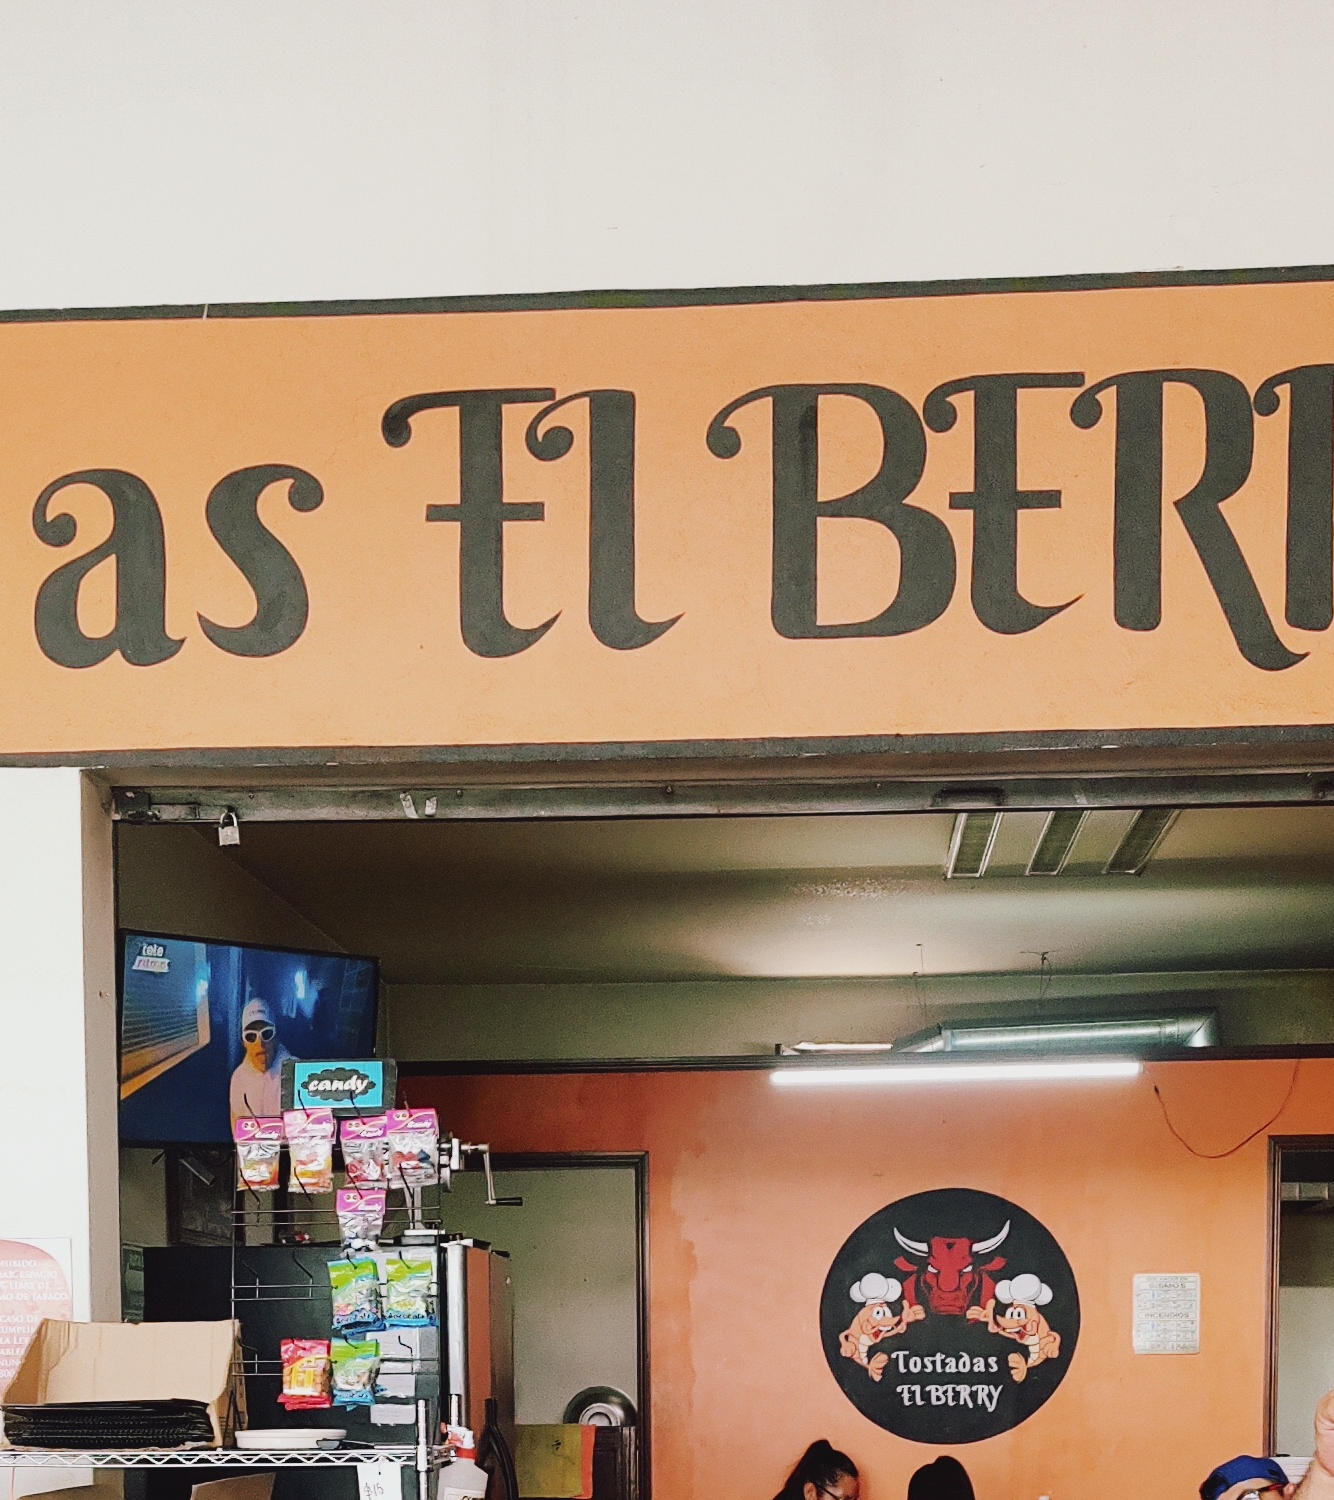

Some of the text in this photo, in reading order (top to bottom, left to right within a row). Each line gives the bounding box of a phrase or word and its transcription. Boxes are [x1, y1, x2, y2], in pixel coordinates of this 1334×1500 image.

[381, 388, 685, 657] El
[308, 1075, 369, 1093] candy
[891, 1351, 998, 1373] Tostadas
[896, 1385, 1003, 1412] El BERRY
[363, 1483, 384, 1500] $15
